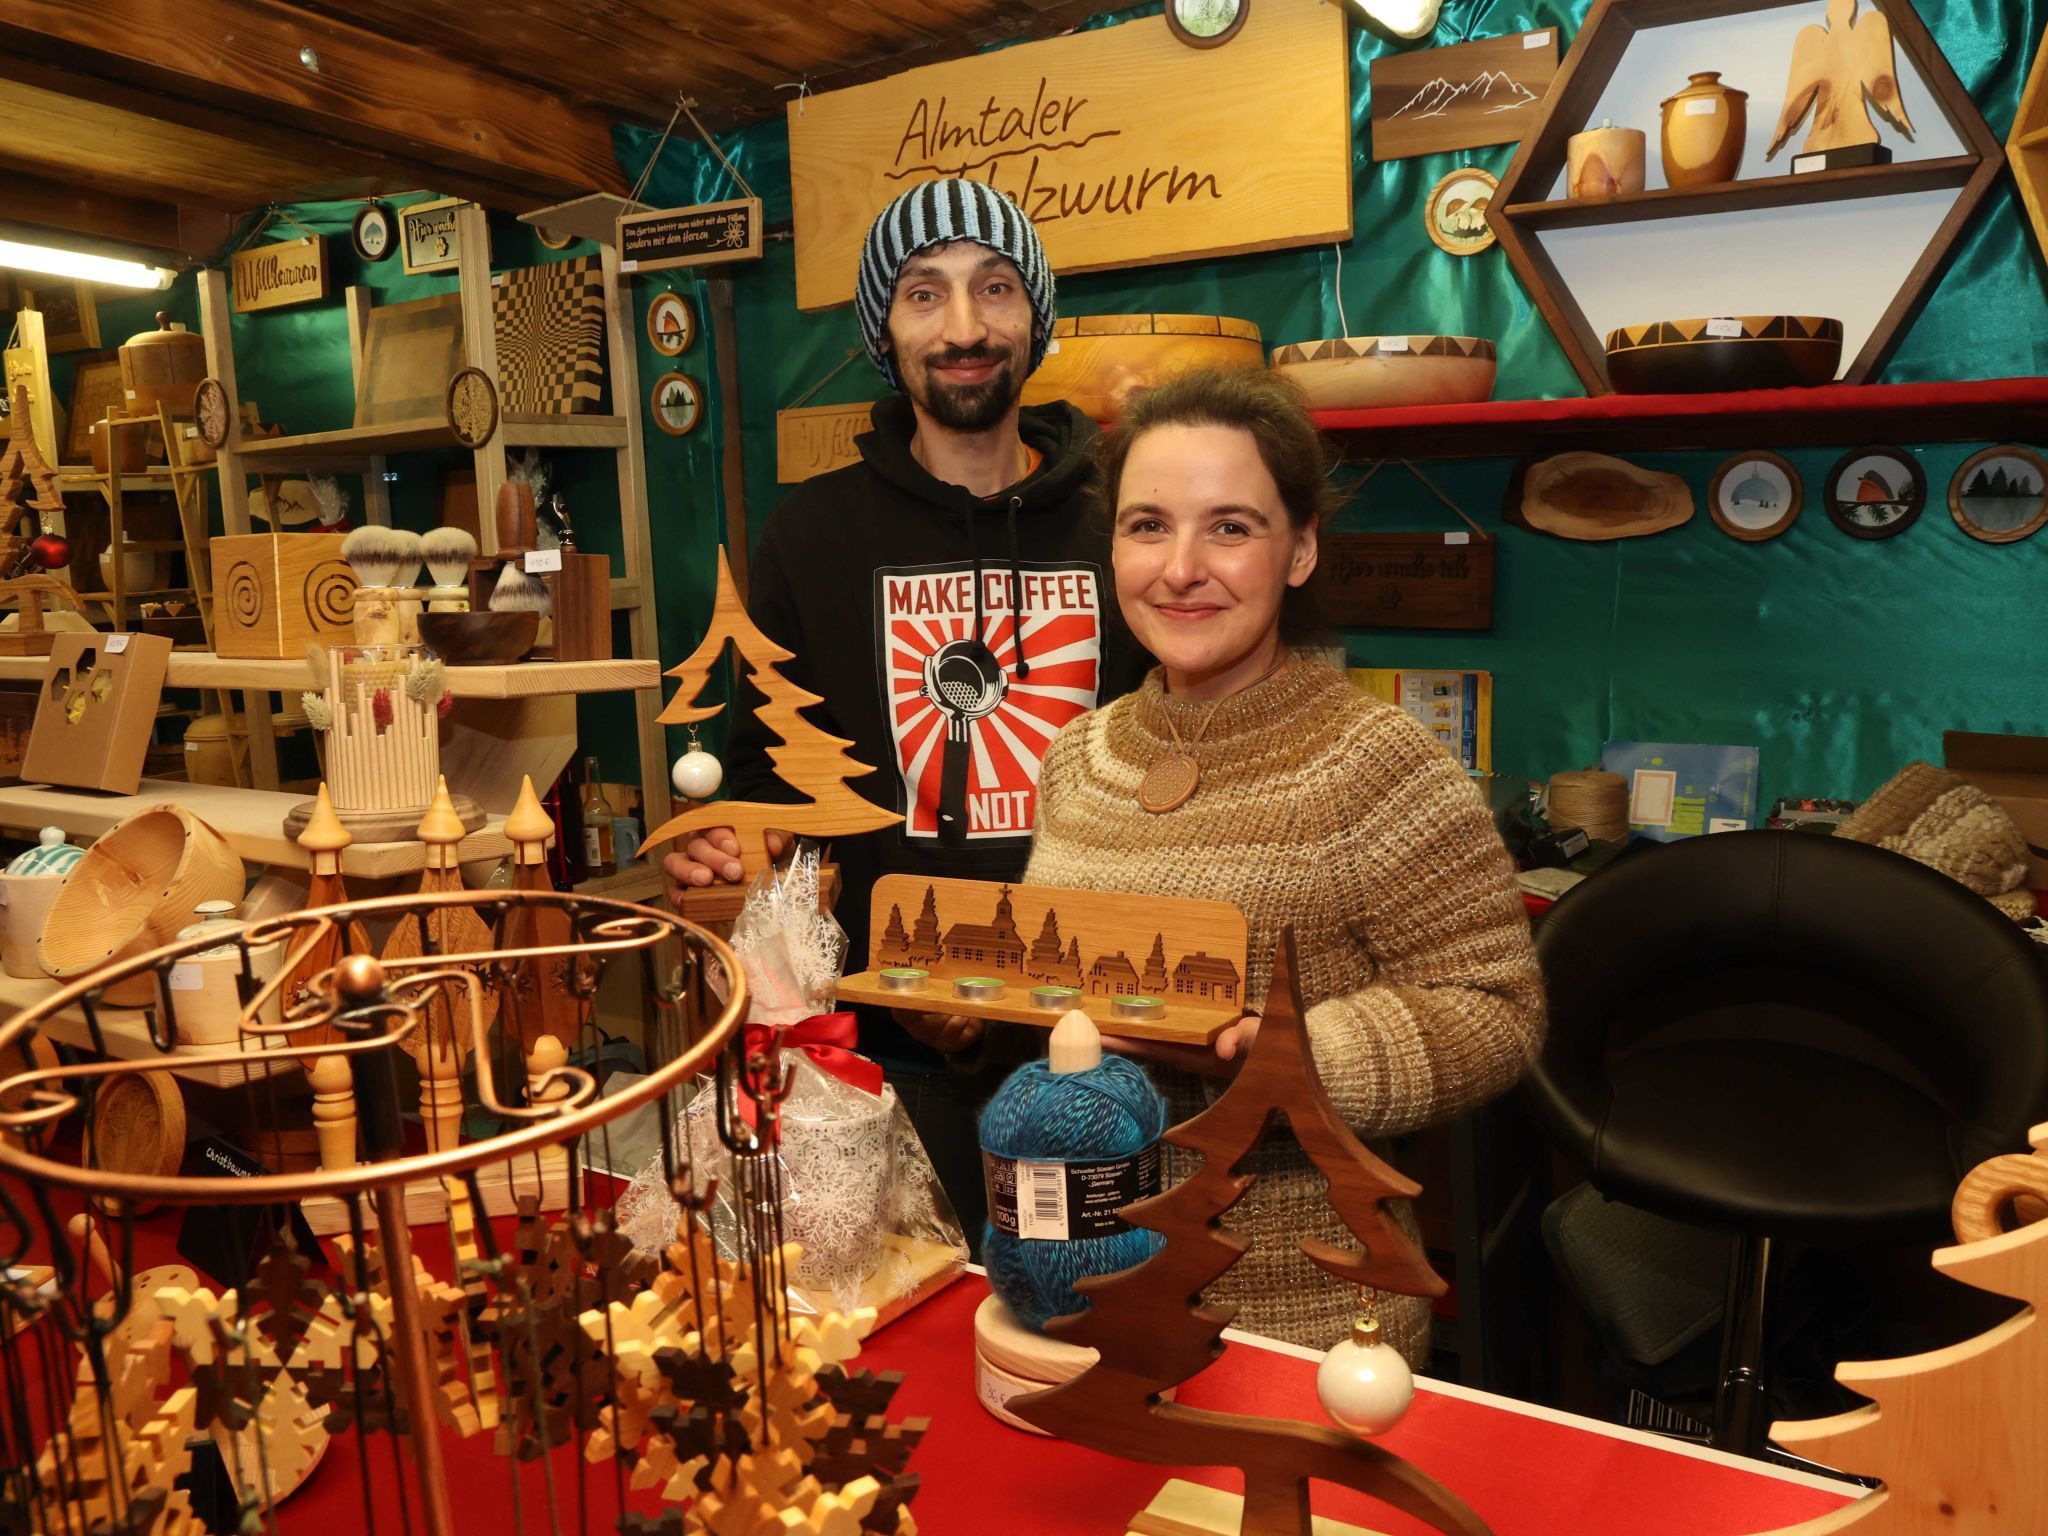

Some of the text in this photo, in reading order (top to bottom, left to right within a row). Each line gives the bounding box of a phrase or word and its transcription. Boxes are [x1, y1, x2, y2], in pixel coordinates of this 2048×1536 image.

[895, 77, 1088, 166] Almtaler
[956, 154, 1222, 225] lzwurm
[626, 229, 709, 251] sondern mit dem Herzen
[636, 225, 657, 237] Garten
[236, 255, 317, 307] Willkommen
[889, 573, 1095, 615] MAKE COFFEE
[968, 790, 1030, 830] NOT
